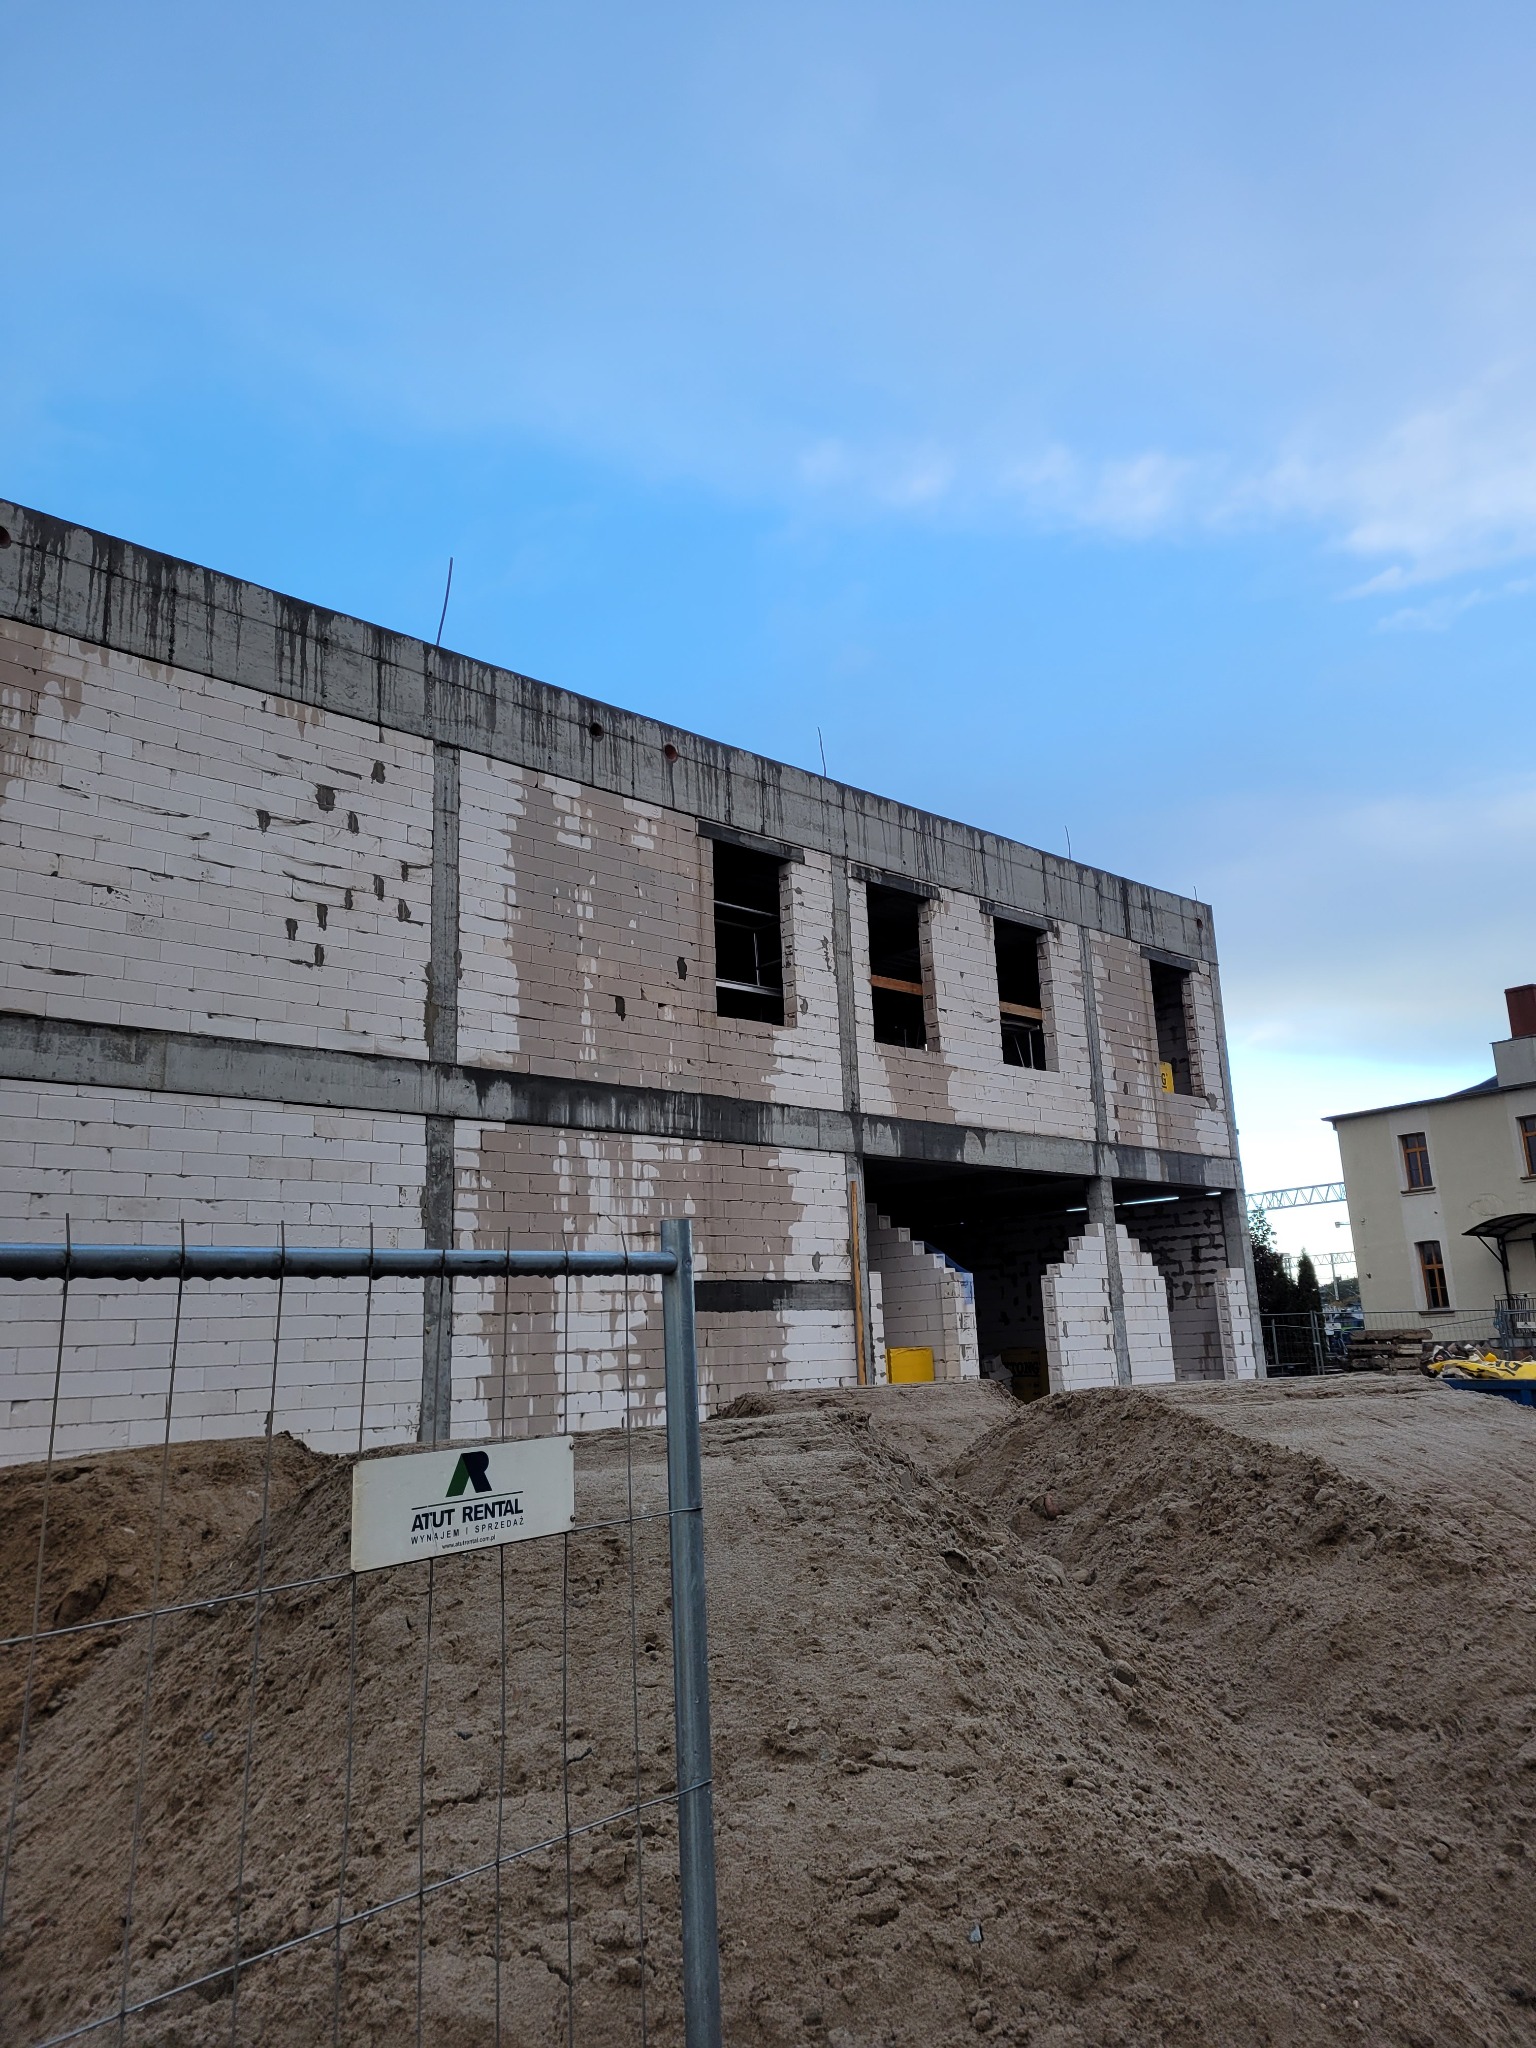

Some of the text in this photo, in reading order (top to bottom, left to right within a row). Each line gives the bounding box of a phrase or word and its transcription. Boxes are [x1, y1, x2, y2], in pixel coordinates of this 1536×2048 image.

[411, 1499, 524, 1532] ATUT RENTAL
[411, 1528, 460, 1545] WYNAJEM
[475, 1516, 525, 1533] SPRZEDAŻ
